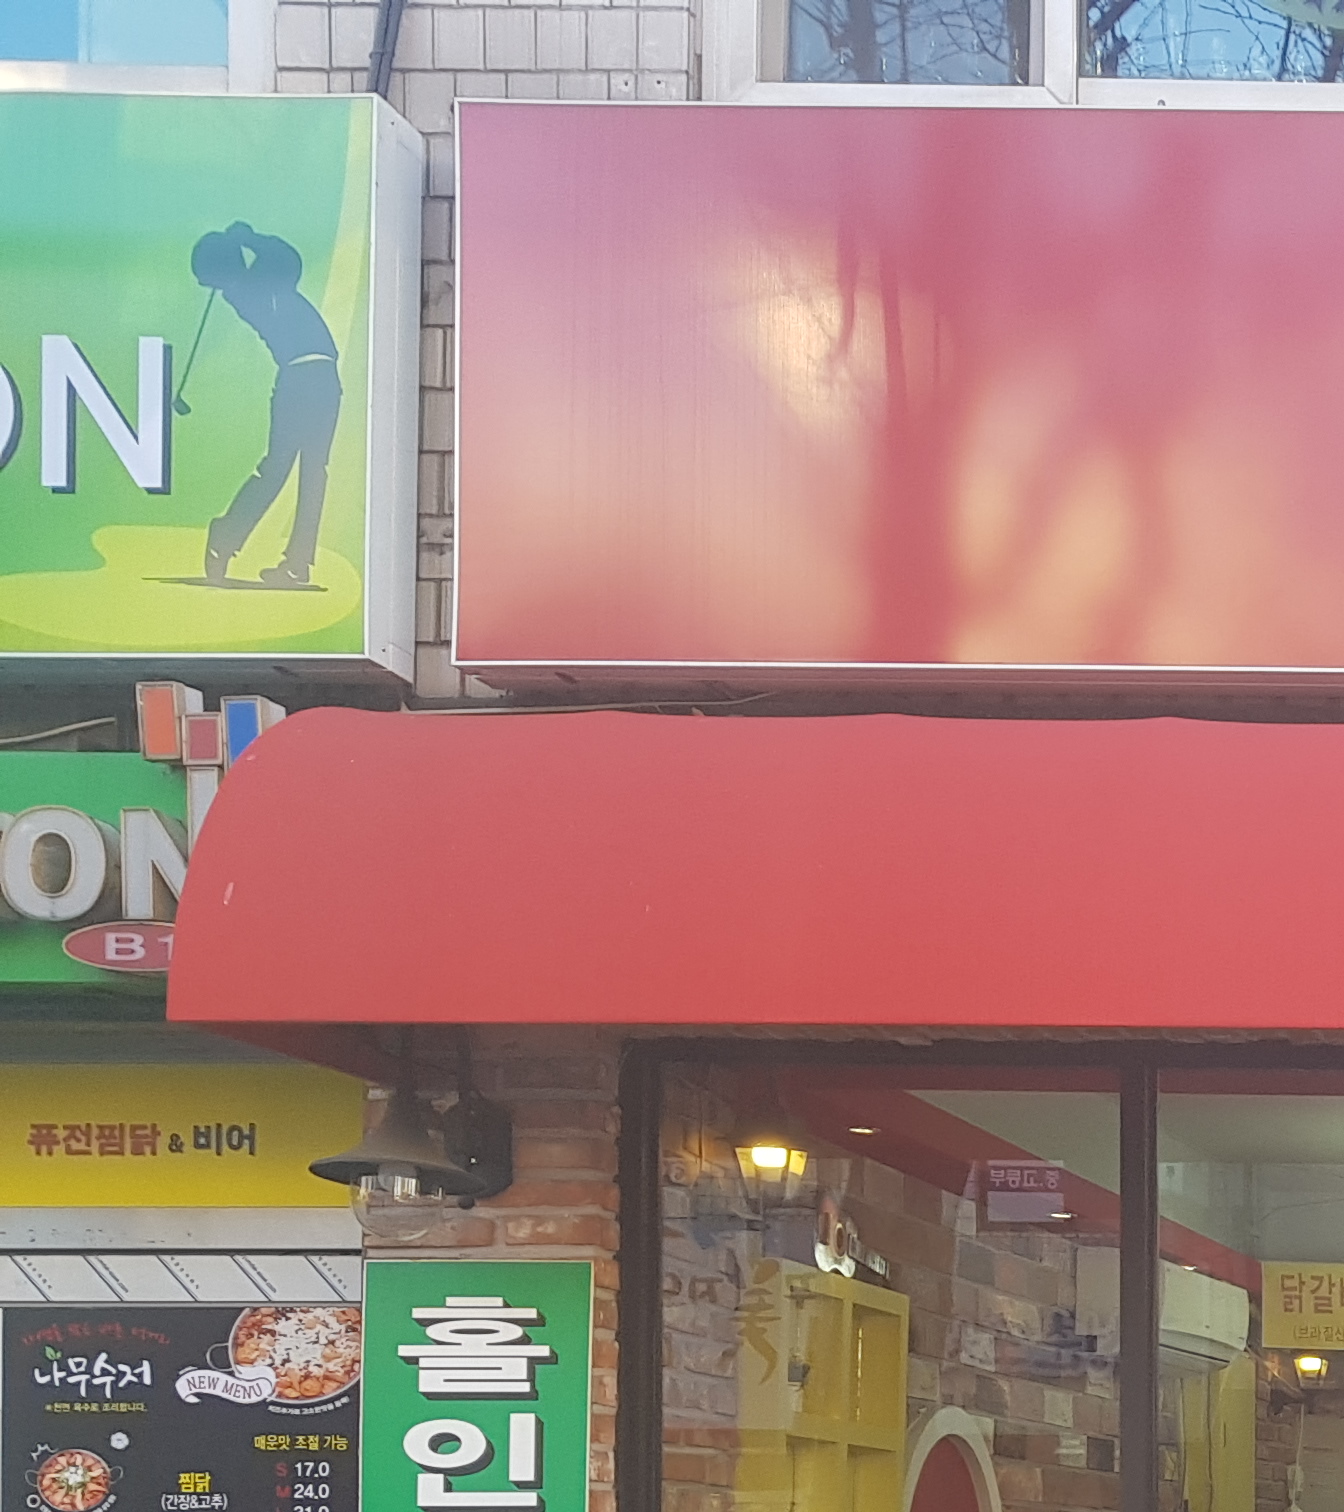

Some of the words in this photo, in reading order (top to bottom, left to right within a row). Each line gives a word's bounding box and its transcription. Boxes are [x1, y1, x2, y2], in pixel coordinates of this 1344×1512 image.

[0, 333, 172, 496] N
[27, 1121, 162, 1157] 퓨전찜닭
[193, 1121, 257, 1157] 비어
[33, 1351, 153, 1399] 나무수저
[186, 1375, 219, 1396] NEW
[222, 1380, 263, 1401] MENU
[253, 1435, 291, 1451] 매운맛
[294, 1435, 320, 1451] 조절
[323, 1435, 349, 1451] 가능
[294, 1462, 330, 1478] 17.0
[178, 1472, 212, 1493] 찜닭
[293, 1484, 330, 1500] 24.0
[161, 1494, 229, 1511] (간장&고추)
